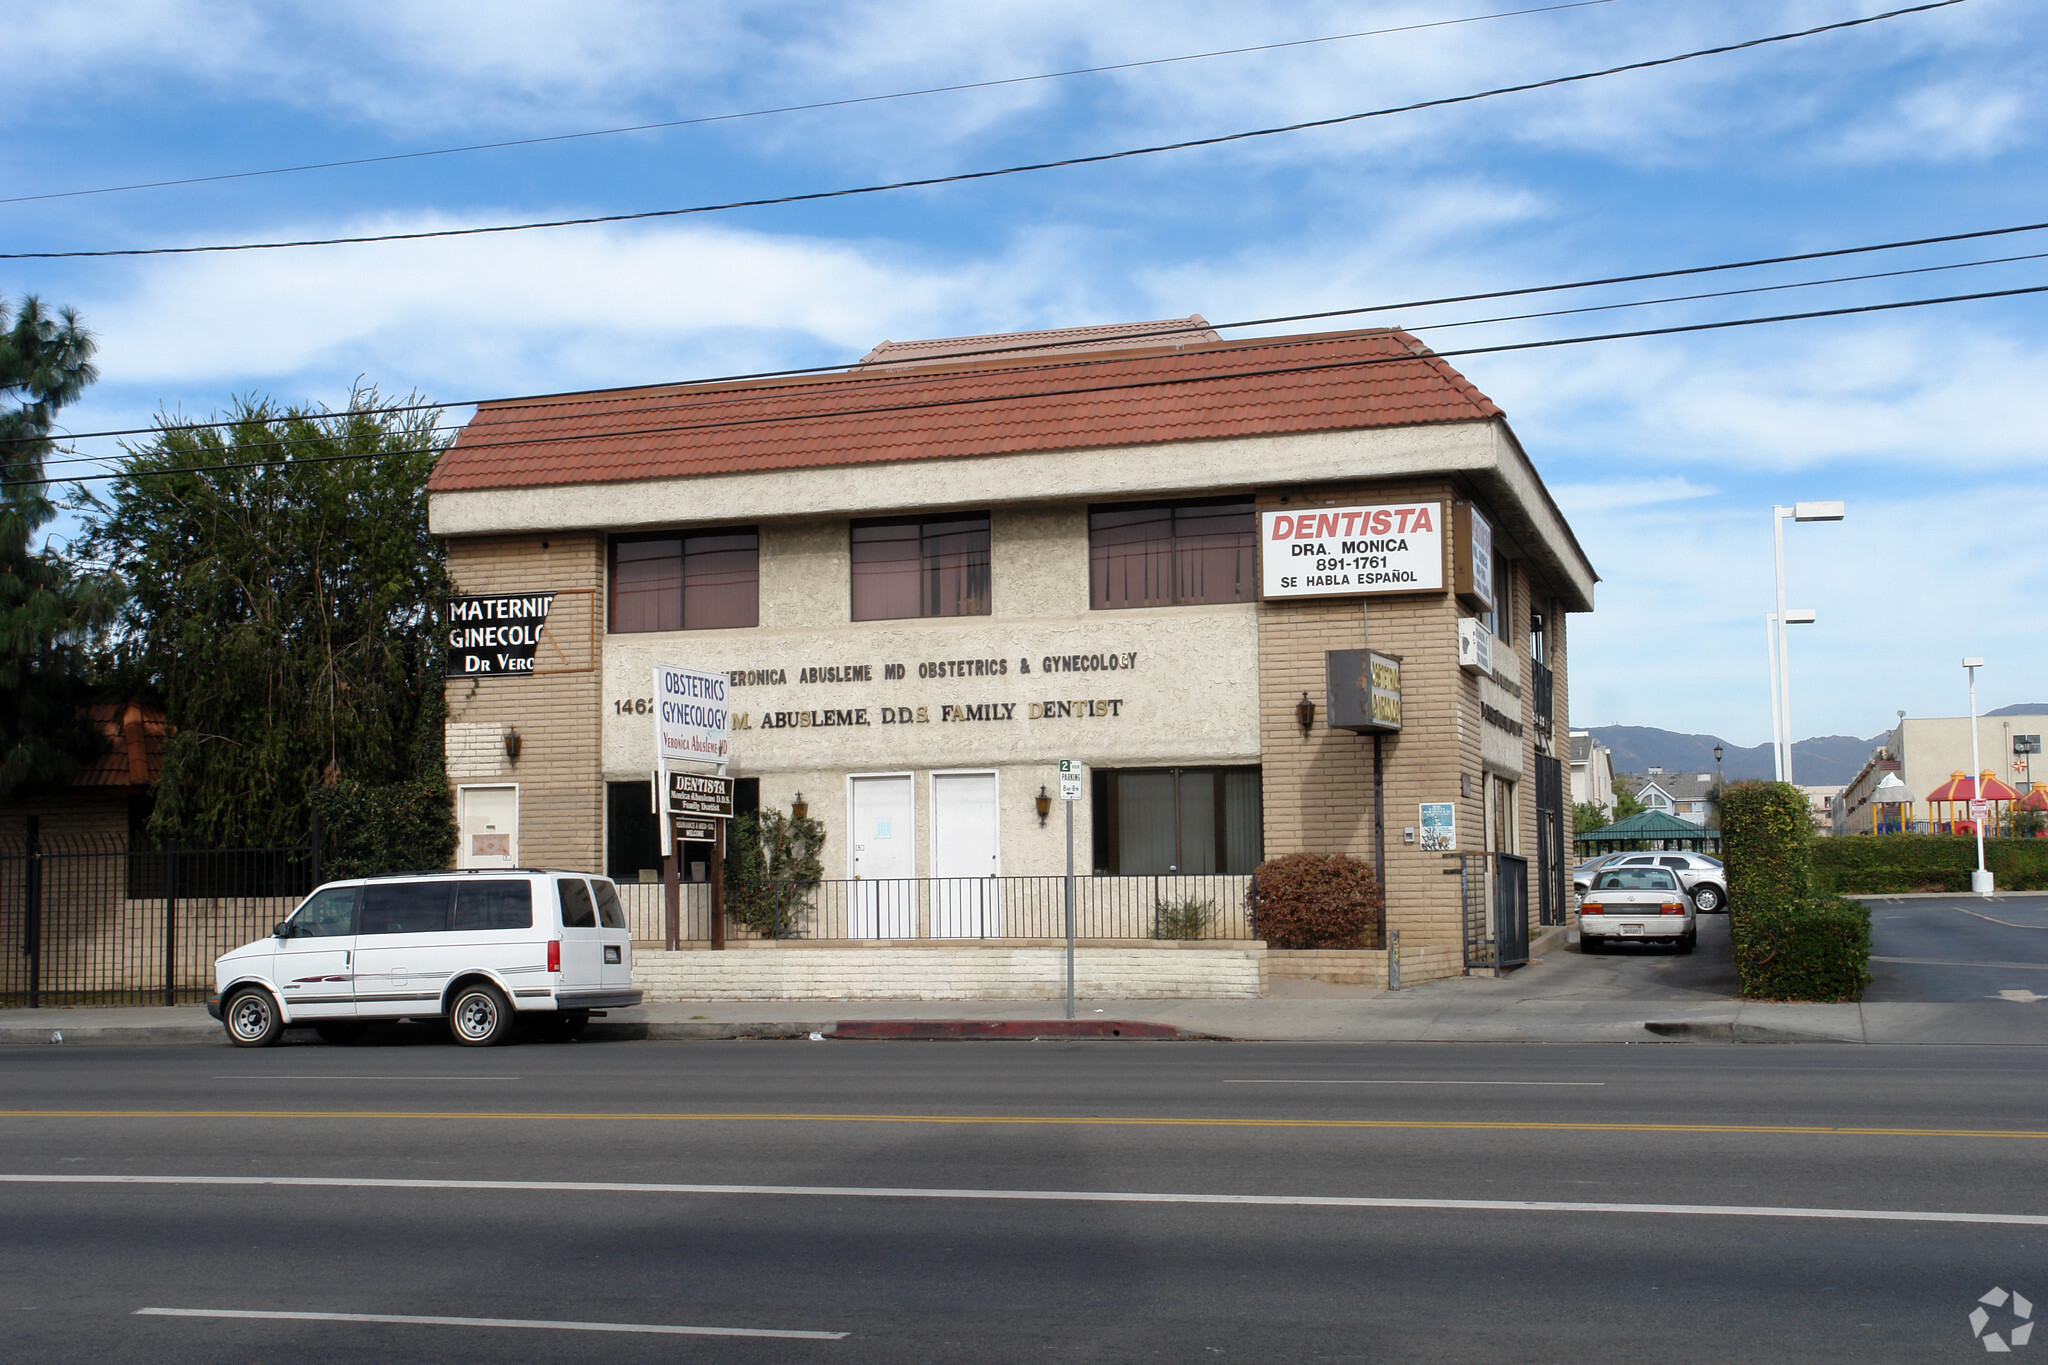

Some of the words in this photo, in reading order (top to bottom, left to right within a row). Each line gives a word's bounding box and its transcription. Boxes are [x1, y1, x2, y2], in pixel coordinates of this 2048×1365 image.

[1271, 507, 1433, 541] DENTISTA
[1291, 543, 1331, 557] DRA.
[1341, 538, 1409, 555] MONICA
[1316, 556, 1387, 571] 891-1761
[1280, 577, 1298, 588] SE
[1306, 574, 1350, 587] HABLA
[1357, 569, 1417, 585] ESPAÑOL
[730, 669, 787, 687] ERONICA
[800, 665, 873, 684] ABUSLEME
[885, 663, 905, 681] MD
[919, 658, 1008, 679] OBSTETRICS
[1020, 657, 1031, 675] &
[1043, 652, 1138, 673] GYNECOLOGY
[665, 671, 725, 702] OBSTETRICS
[662, 701, 727, 730] GYNECOLOGY
[731, 712, 752, 730] M.
[761, 708, 871, 729] ABUSLEME,
[941, 702, 1017, 722] FAMILY
[1028, 699, 1123, 720] DENTIST
[1062, 761, 1068, 771] 2
[676, 776, 726, 795] DENTISTA
[1061, 773, 1081, 782] PARKING
